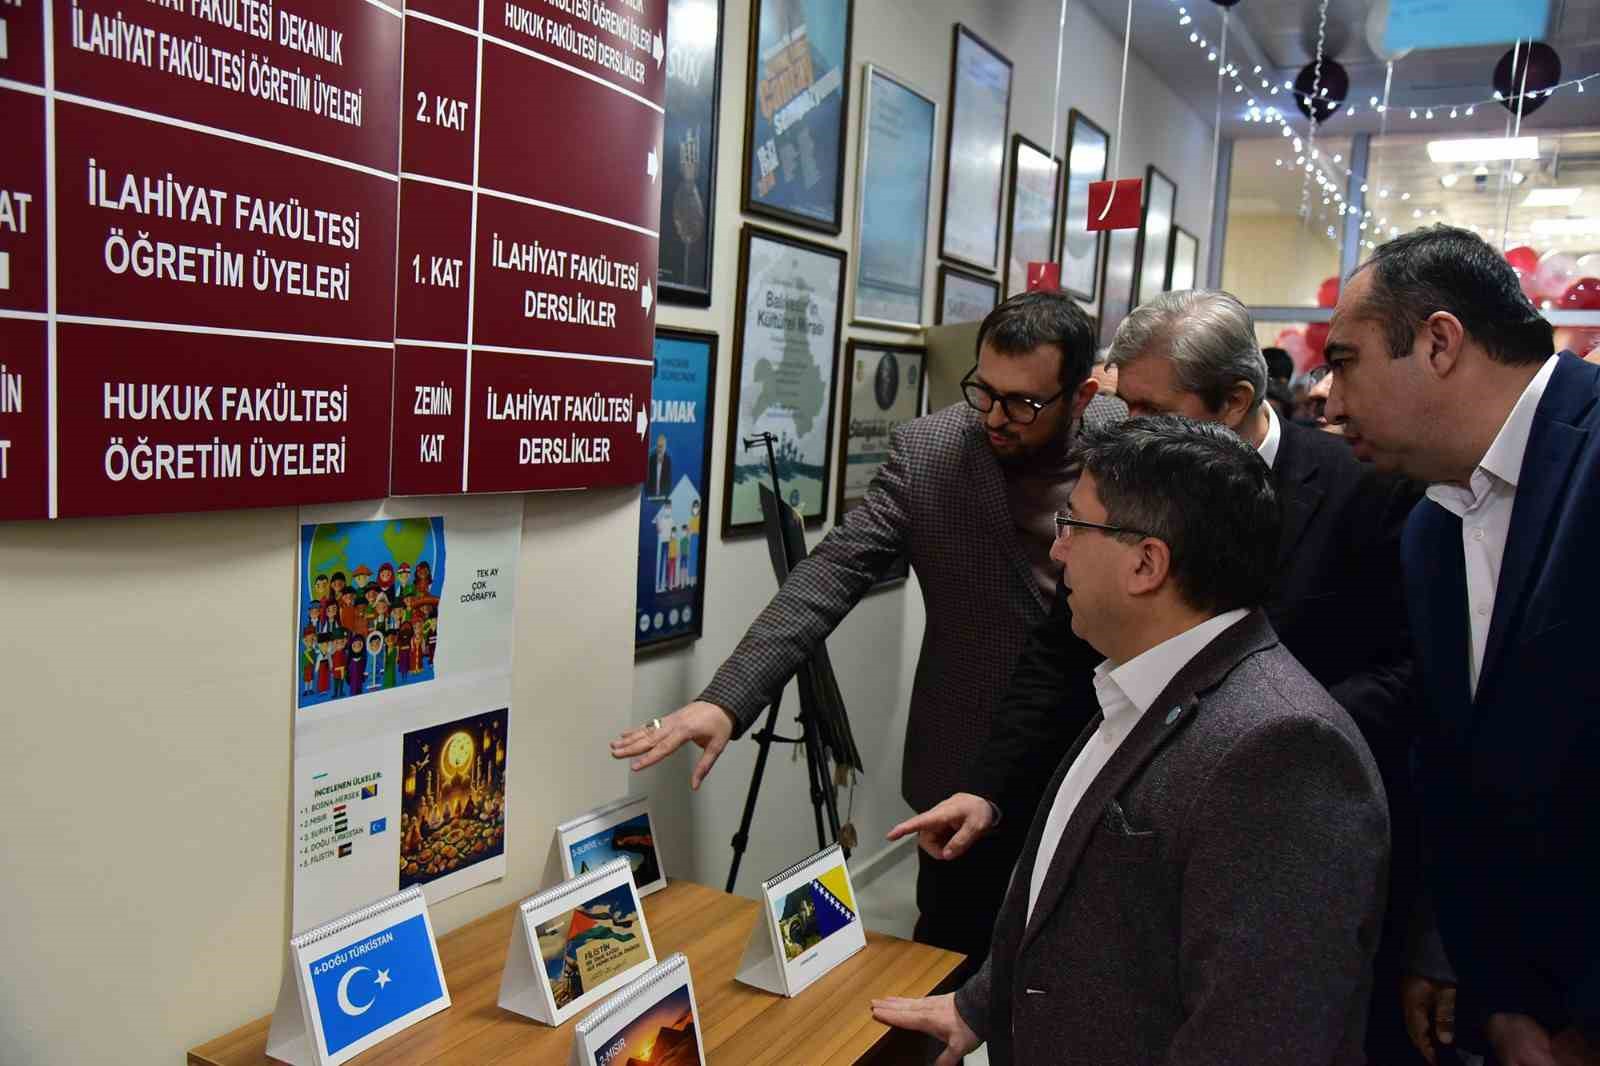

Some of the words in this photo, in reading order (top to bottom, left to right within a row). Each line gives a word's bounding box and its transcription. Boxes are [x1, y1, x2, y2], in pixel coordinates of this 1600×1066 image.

[280, 10, 343, 66] DEKANLIK
[505, 3, 544, 39] HUKUK
[546, 20, 597, 61] FAKÜLTESİ
[598, 43, 645, 84] DERSLİKLER
[72, 0, 156, 67] İLAHİYAT
[160, 32, 245, 93] FAKÜLTESİ
[249, 53, 311, 112] ÖĞRETİM
[313, 75, 362, 127] ÜYELERİ
[416, 91, 431, 123] 2.
[436, 95, 468, 131] KAT
[88, 158, 227, 226] İLAHİYAT
[235, 195, 361, 250] FAKÜLTESİ
[105, 228, 244, 288] ÖĞRETİM
[252, 250, 350, 300] ÜYELERİ
[412, 254, 426, 285] 1.
[430, 257, 463, 288] KAT
[492, 232, 568, 278] İLAHİYAT
[570, 254, 639, 291] FAKÜLTESİ
[524, 290, 616, 328] DERSLİKLER
[104, 382, 213, 421] HUKUK
[222, 383, 348, 422] FAKÜLTESİ
[414, 381, 452, 416] ZEMİN
[487, 386, 562, 421] İLAHİYAT
[564, 393, 633, 423] FAKÜLTESİ
[105, 436, 242, 481] ÖĞRETİM
[250, 436, 346, 477] ÜYELERİ
[420, 434, 445, 463] KAT
[519, 433, 610, 464] DERSLİKLER
[472, 581, 486, 591] ÇOK
[477, 569, 489, 577] TEK
[314, 955, 348, 976] 4-DOĞU
[349, 932, 394, 960] TÜRKİSTAN
